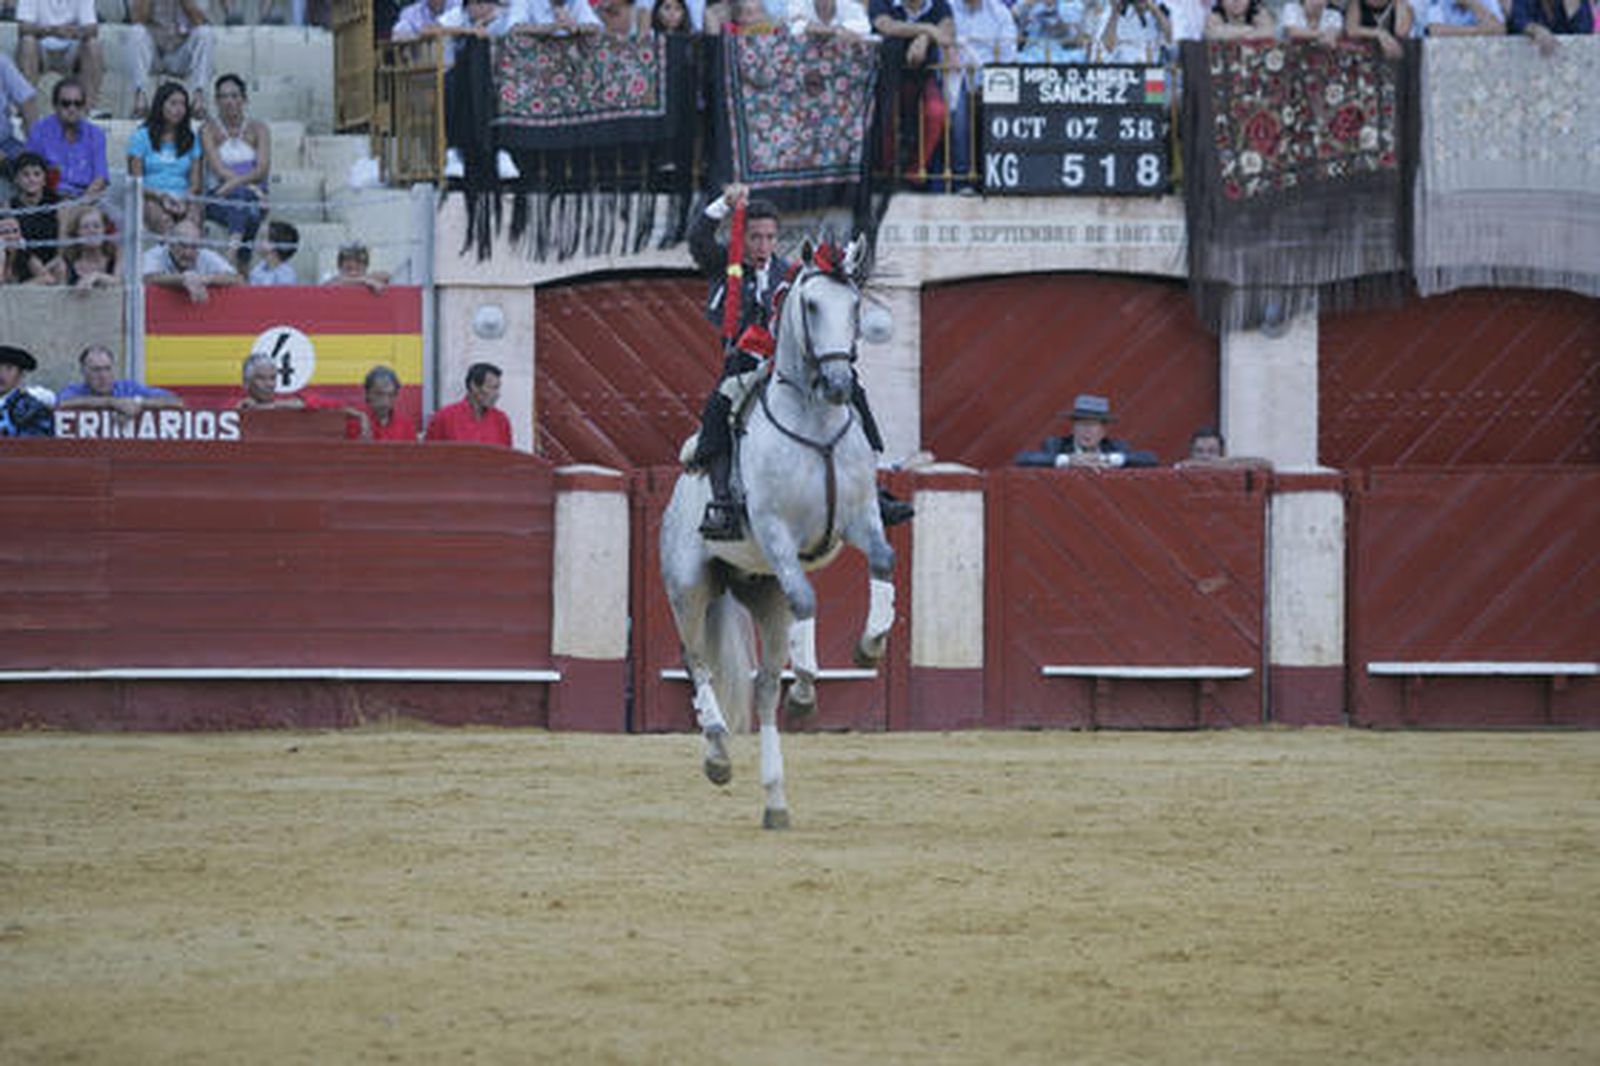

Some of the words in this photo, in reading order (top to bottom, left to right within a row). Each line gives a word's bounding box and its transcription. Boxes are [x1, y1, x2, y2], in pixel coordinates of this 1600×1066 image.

[1038, 82, 1128, 104] SANCHEZ
[991, 116, 1047, 140] OCT
[1065, 117, 1099, 140] 07
[1118, 117, 1154, 140] 38
[984, 152, 1020, 188] KG
[270, 333, 294, 386] 4
